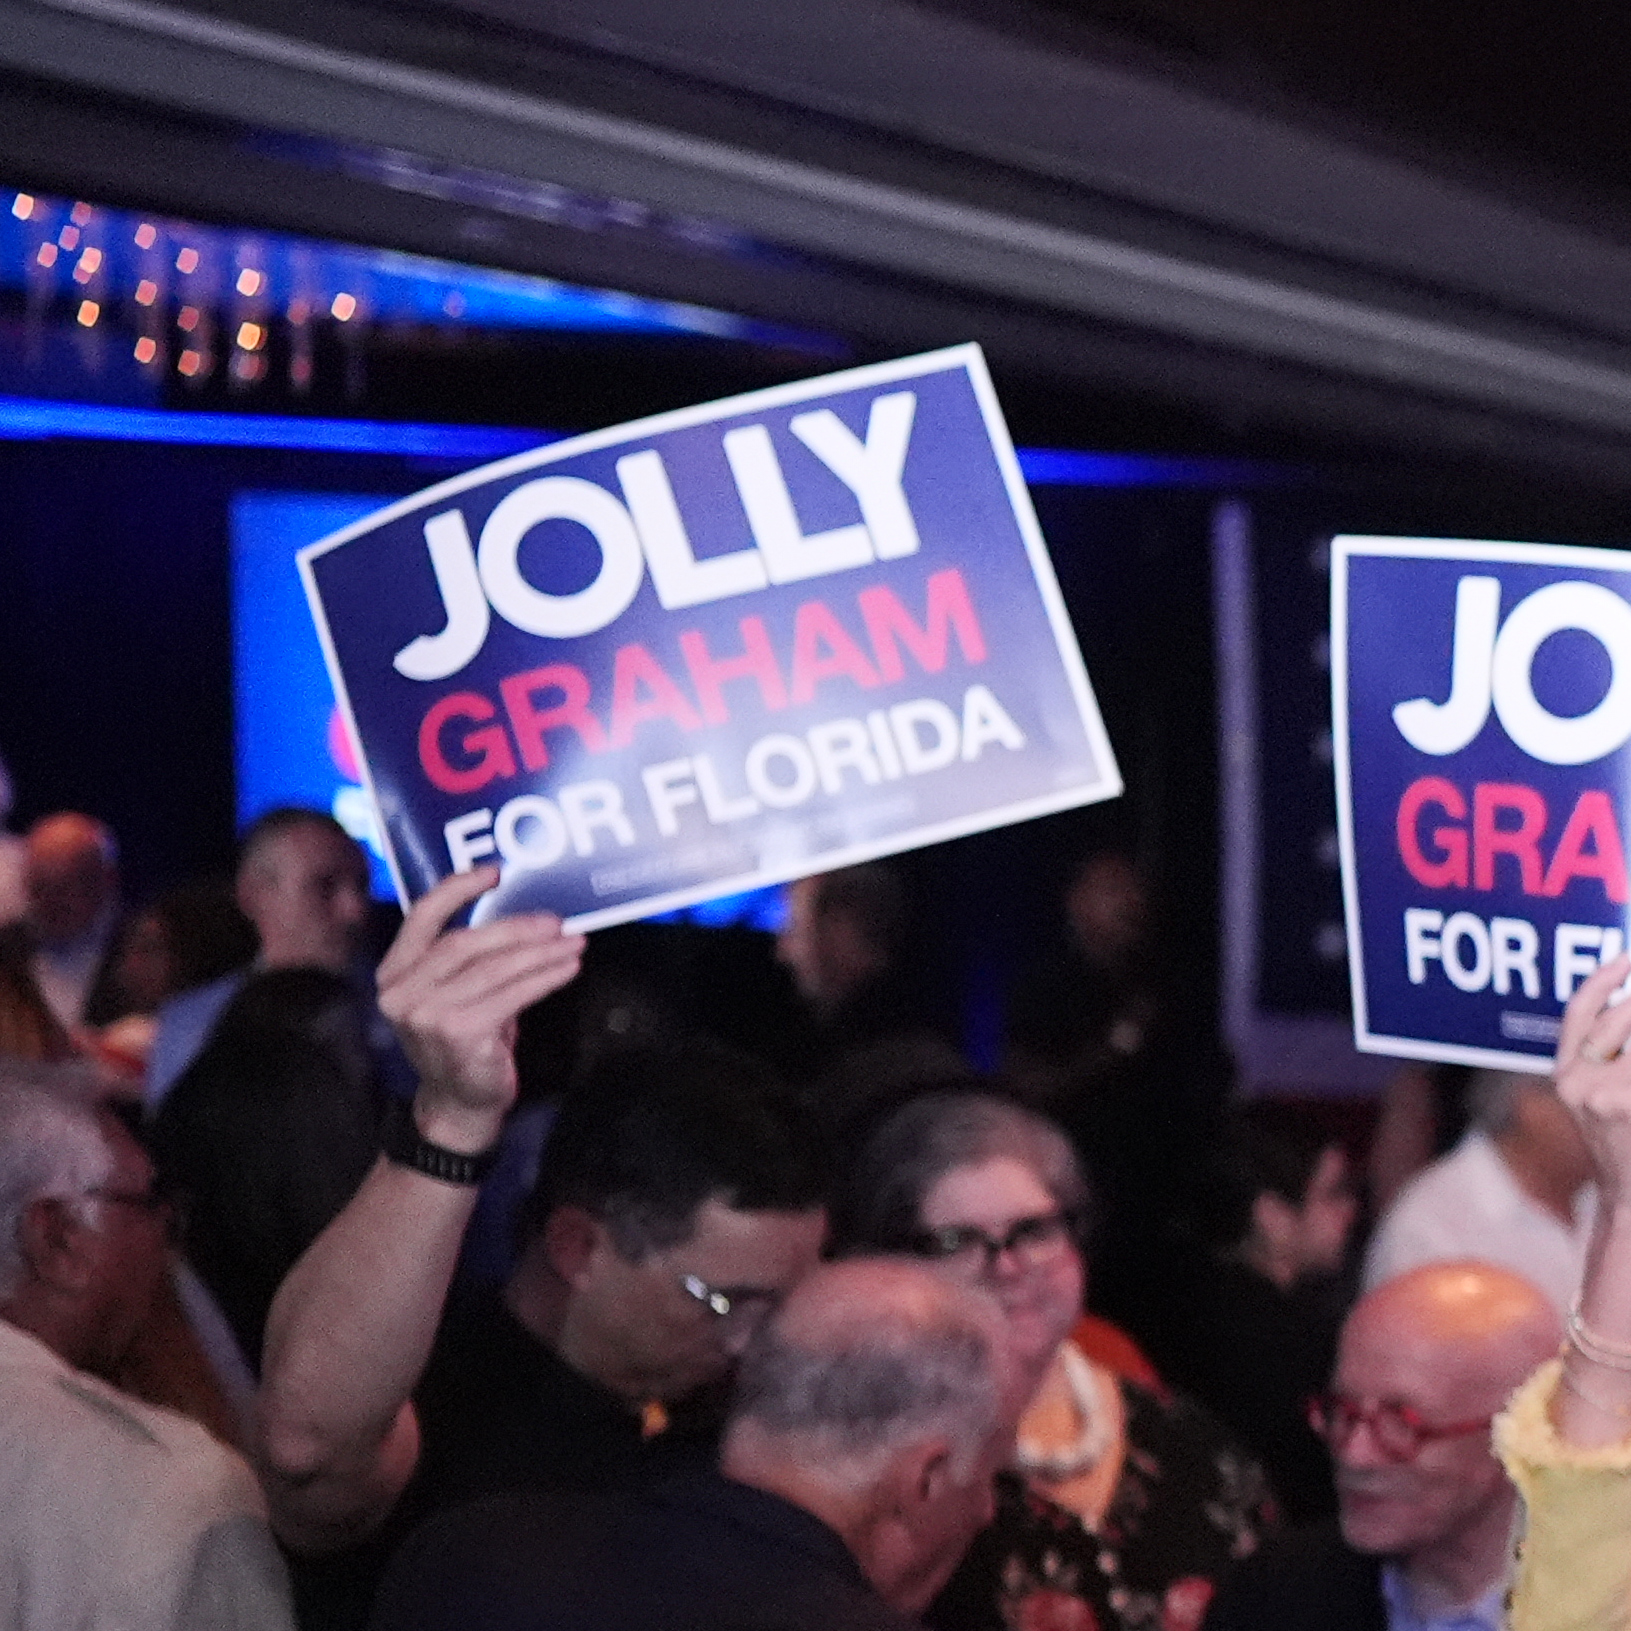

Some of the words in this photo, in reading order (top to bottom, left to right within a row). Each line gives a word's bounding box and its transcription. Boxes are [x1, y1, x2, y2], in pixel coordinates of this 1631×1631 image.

[393, 391, 920, 681] JOLLY
[418, 567, 987, 795] GRAHAM
[444, 788, 634, 877] FOR
[642, 684, 1026, 842] FLORIDA
[1403, 907, 1540, 999] FOR
